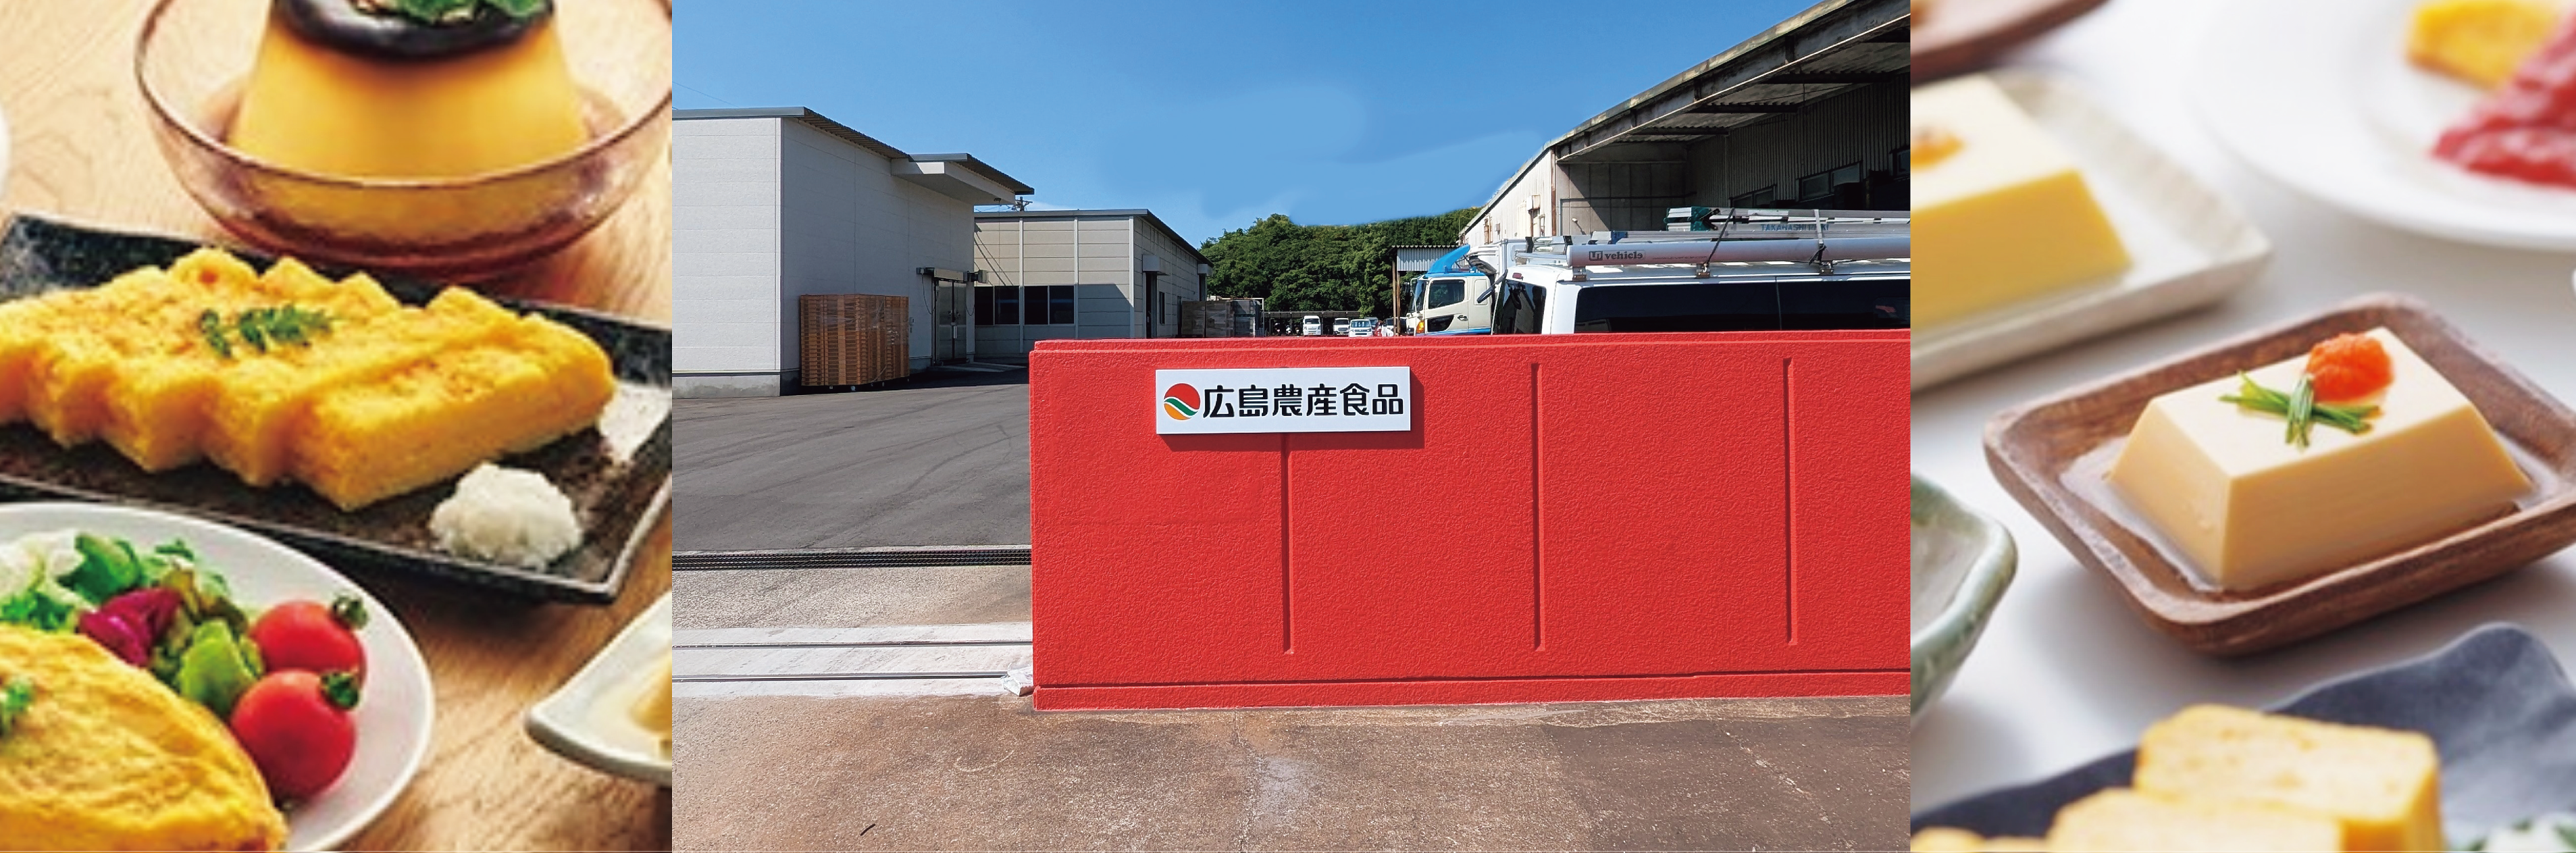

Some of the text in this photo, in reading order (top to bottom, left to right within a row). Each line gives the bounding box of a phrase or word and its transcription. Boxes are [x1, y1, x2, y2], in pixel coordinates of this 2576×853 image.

[1605, 251, 1643, 260] vehicle
[1203, 383, 1403, 418] 広島農産食品
